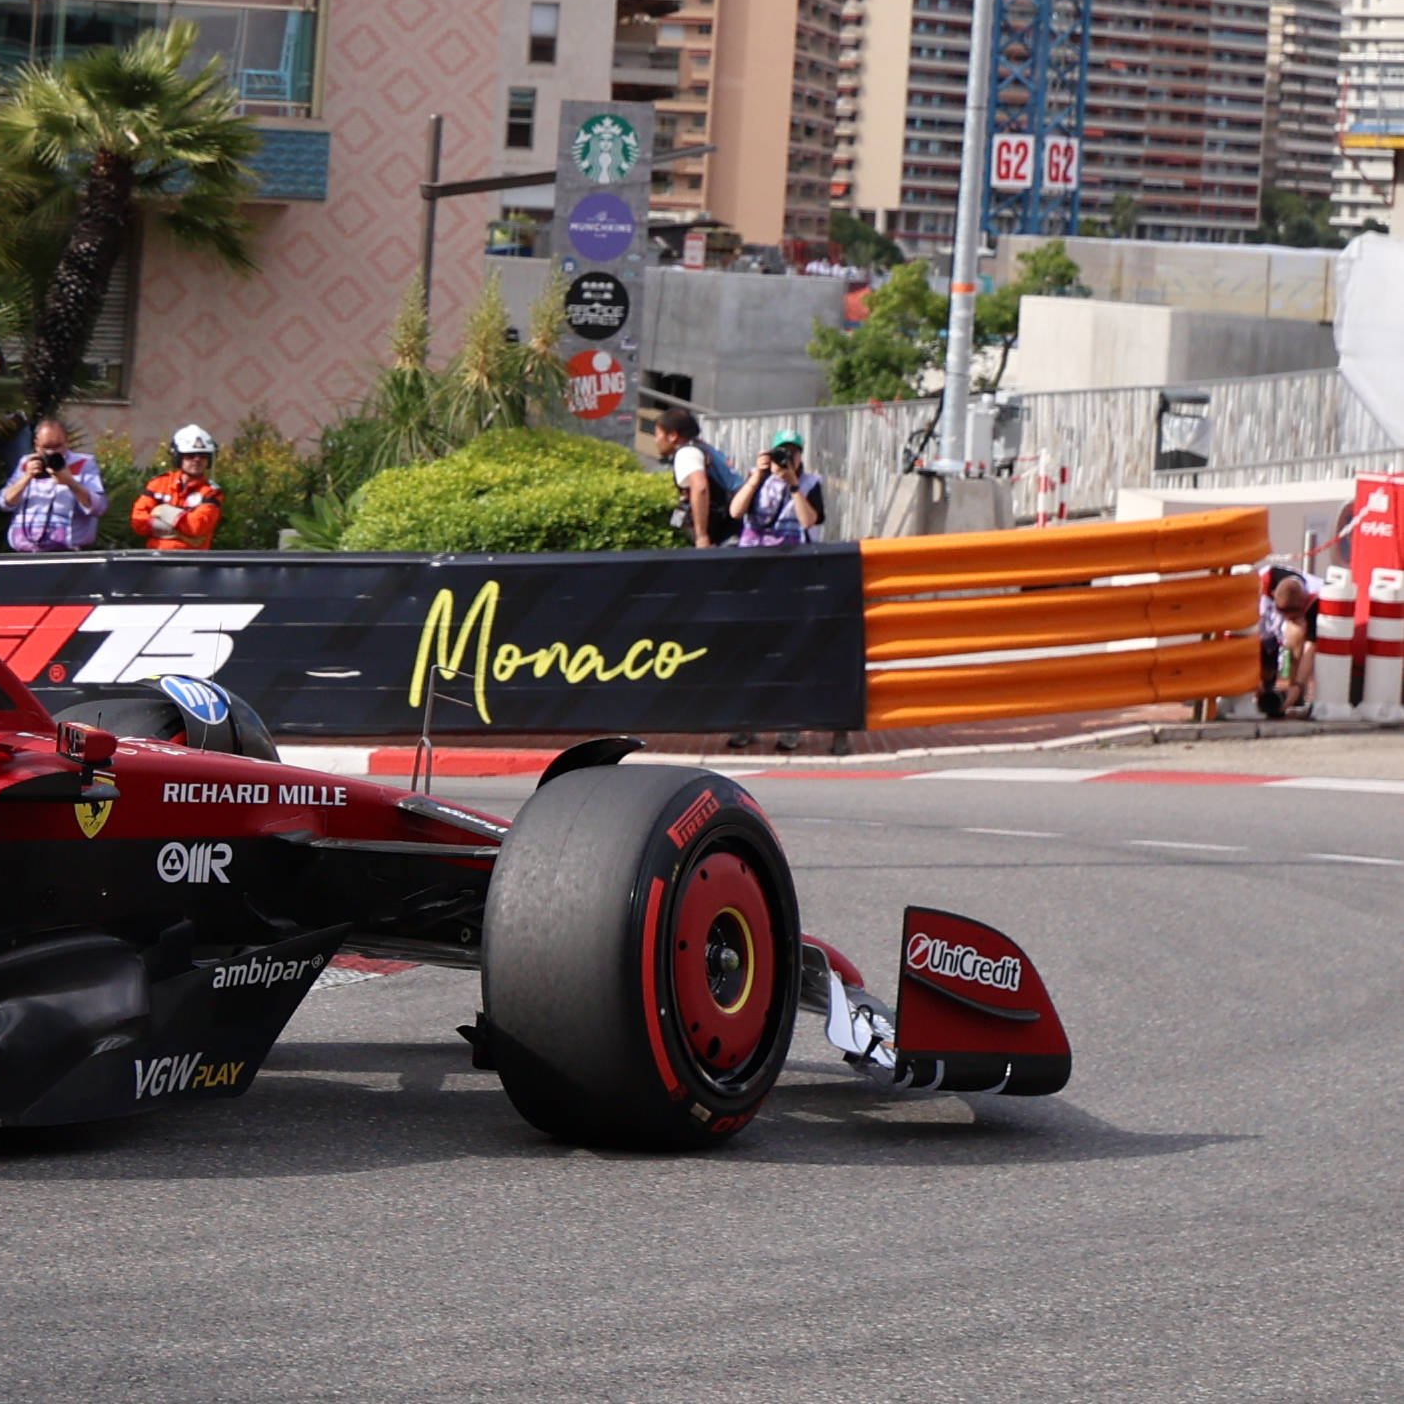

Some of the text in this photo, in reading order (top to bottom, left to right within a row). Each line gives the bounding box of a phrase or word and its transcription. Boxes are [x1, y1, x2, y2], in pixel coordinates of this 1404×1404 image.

[407, 579, 709, 725] Monaco
[162, 782, 347, 807] RICHARD MILLE
[666, 789, 721, 850] PIRELLI
[212, 955, 310, 989] ambipar
[930, 942, 1020, 989] UniCredit
[134, 1053, 245, 1100] VGW PLAY
